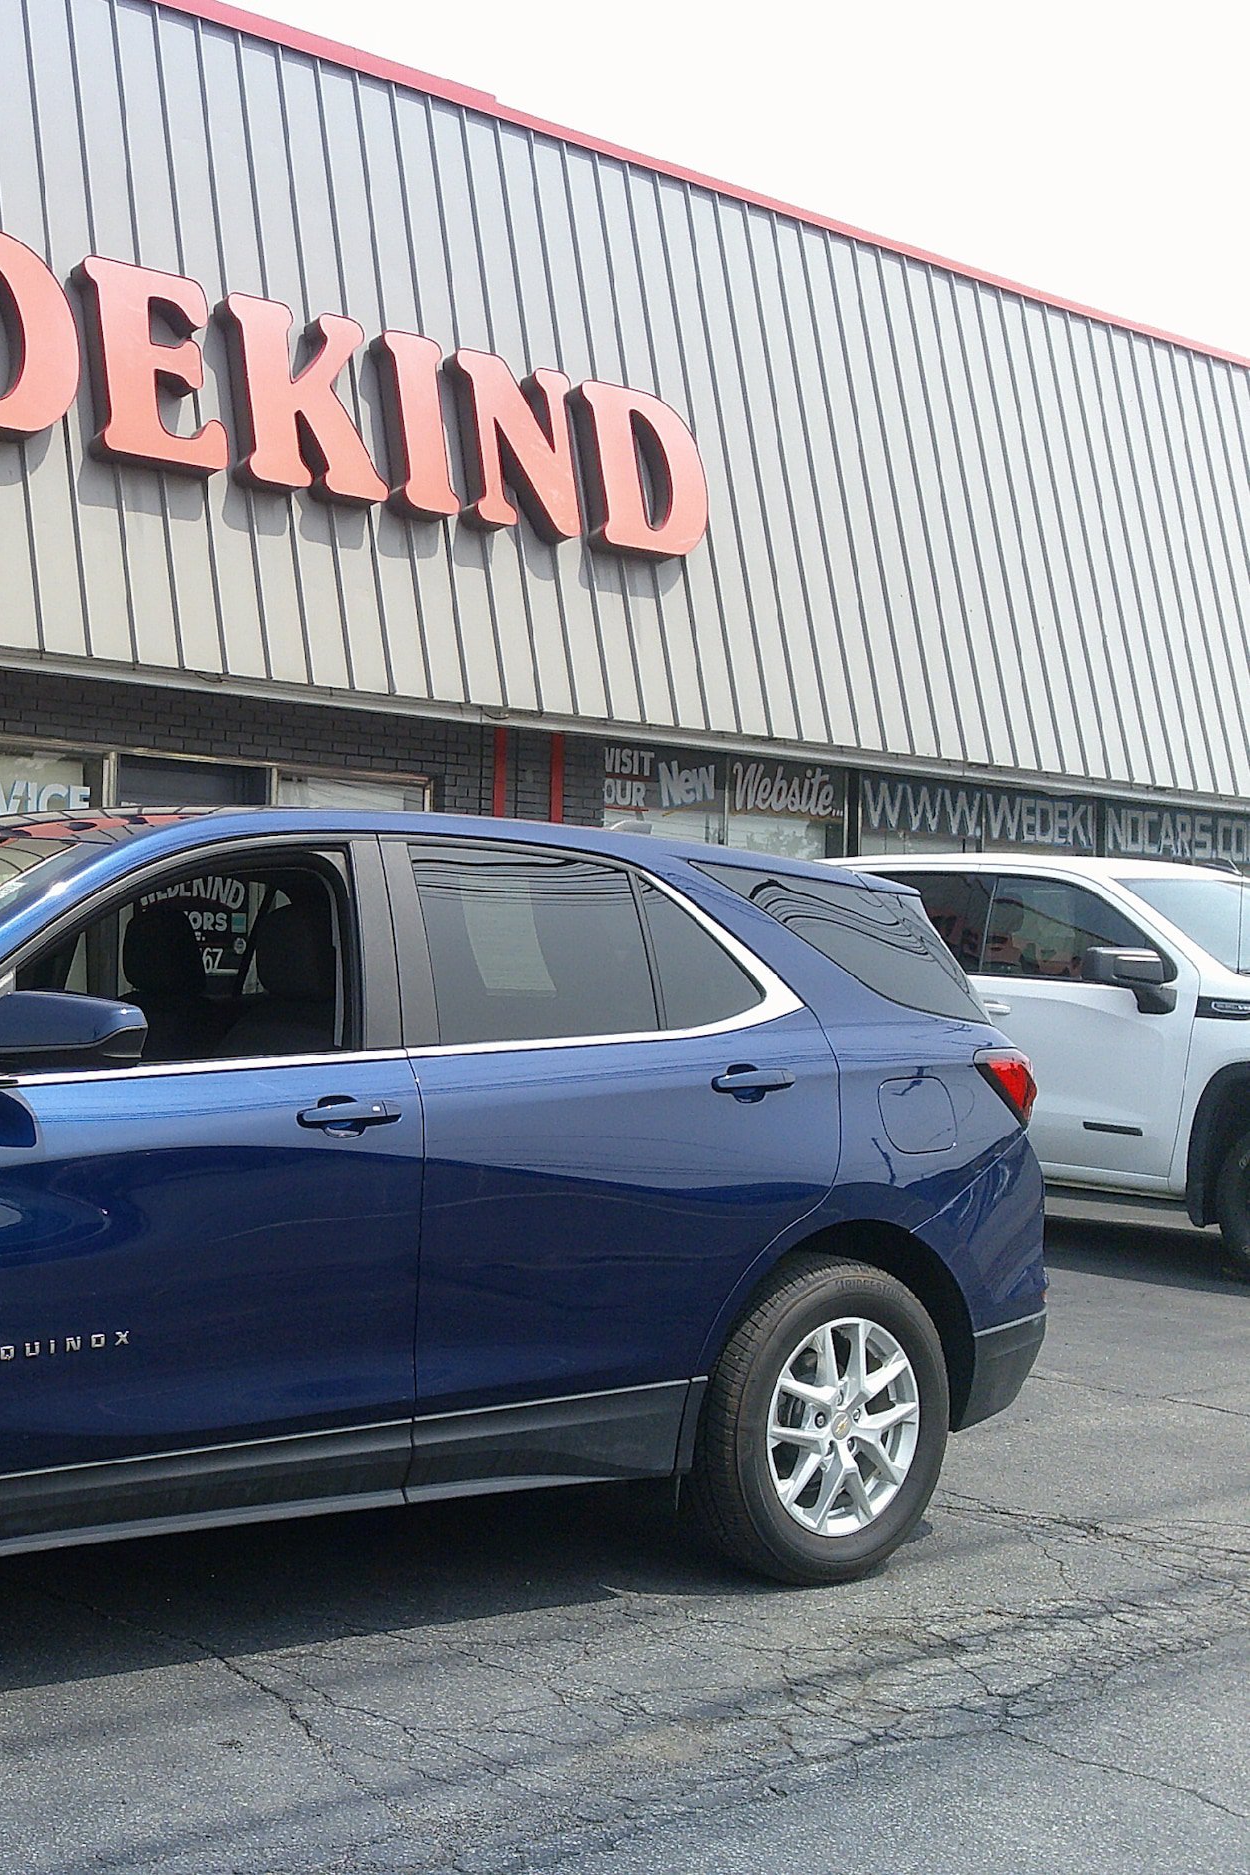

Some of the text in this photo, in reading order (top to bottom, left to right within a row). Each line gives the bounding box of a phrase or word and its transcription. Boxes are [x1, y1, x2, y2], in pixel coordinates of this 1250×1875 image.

[604, 747, 655, 776] VISIT
[603, 778, 647, 807] OUR
[658, 760, 716, 809] New
